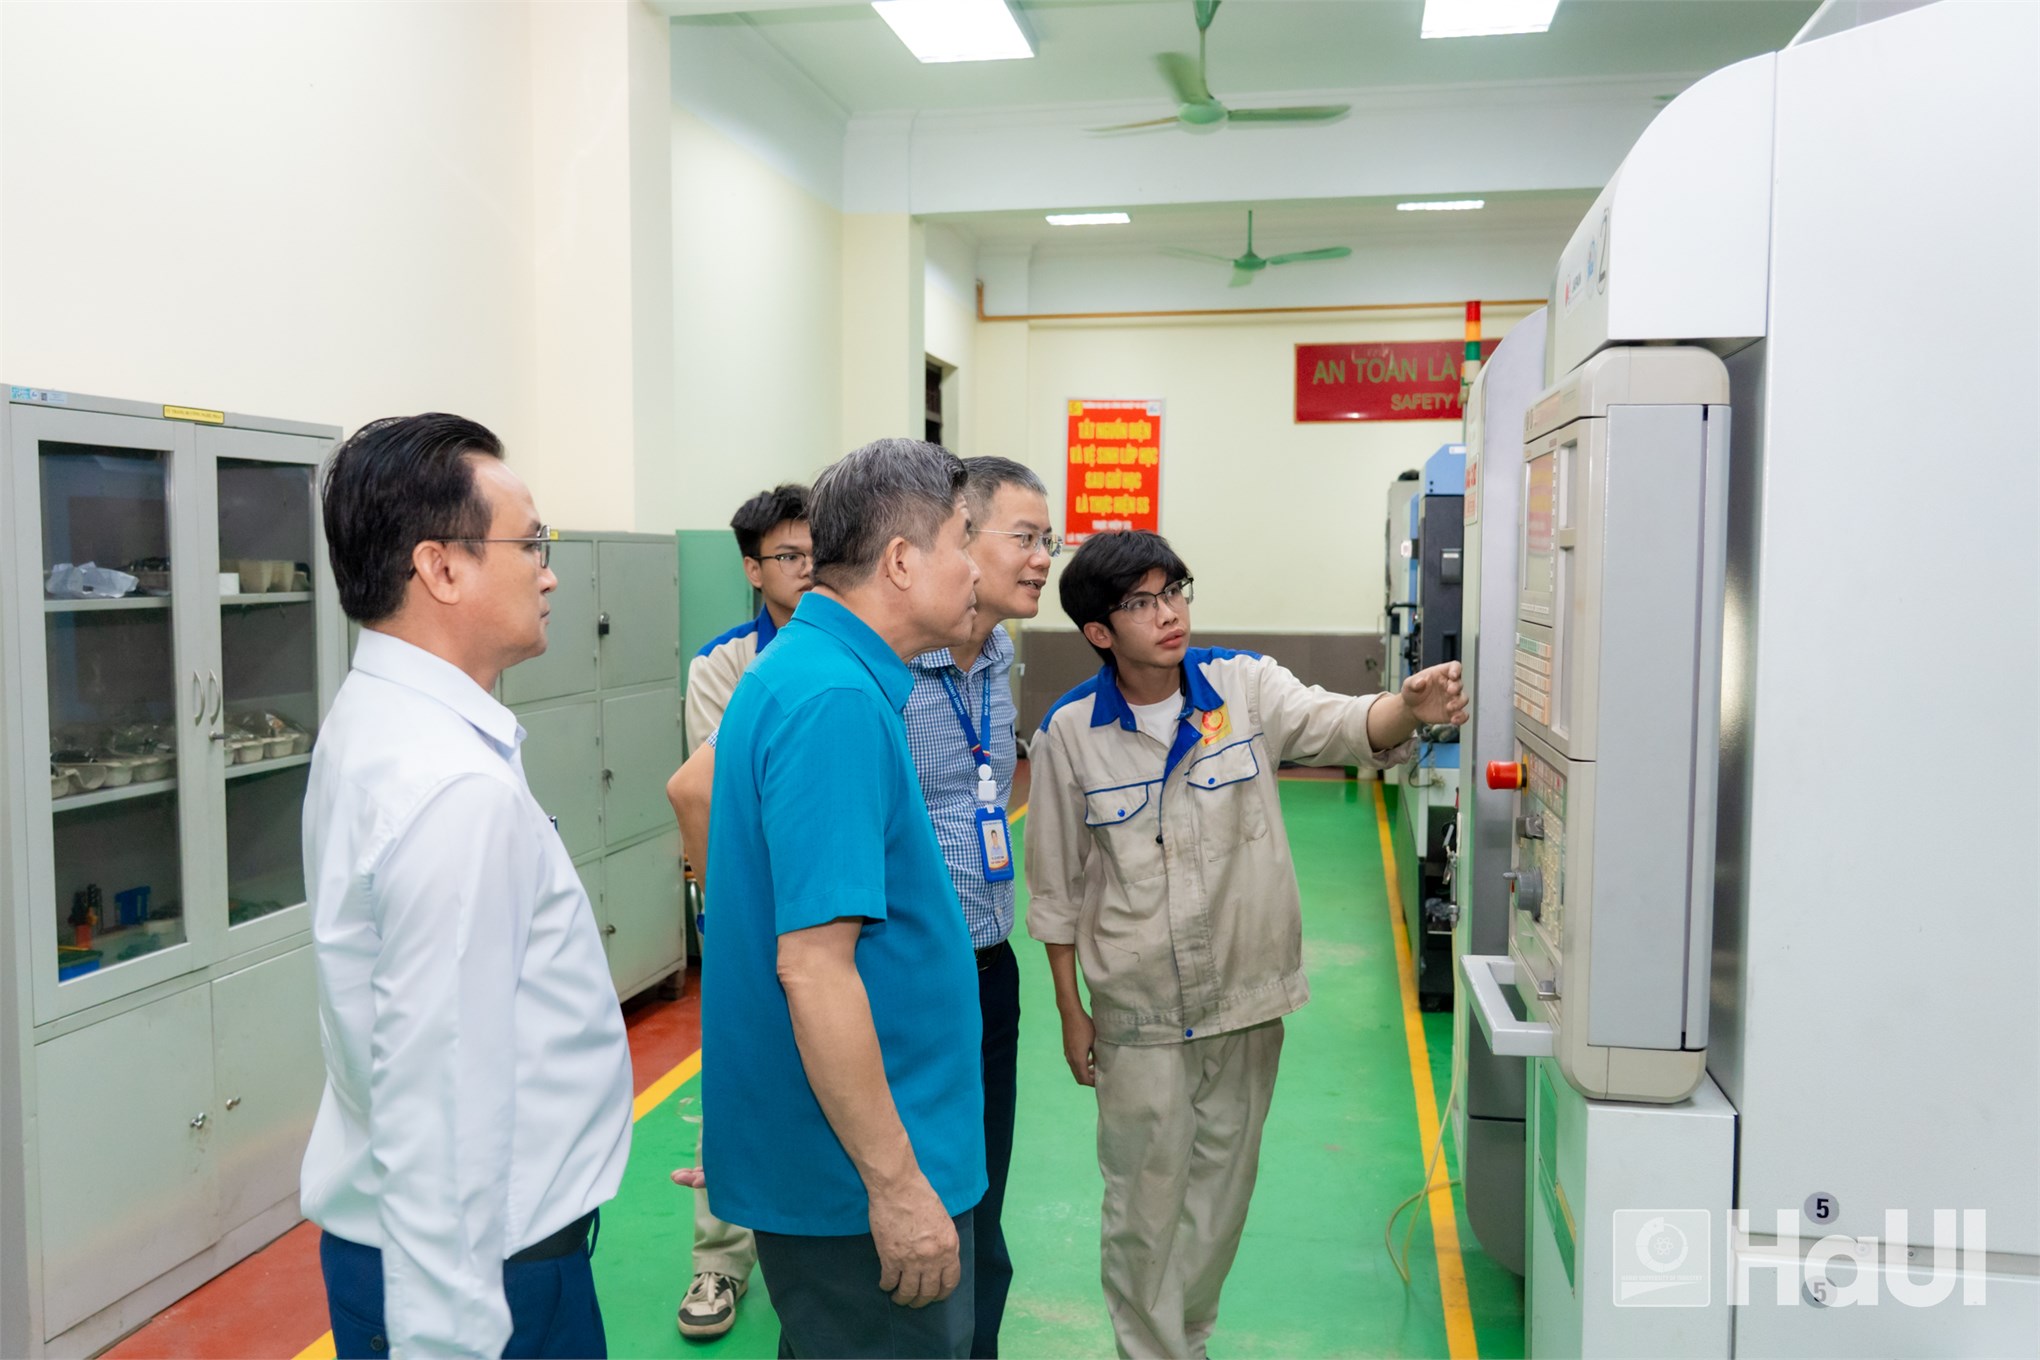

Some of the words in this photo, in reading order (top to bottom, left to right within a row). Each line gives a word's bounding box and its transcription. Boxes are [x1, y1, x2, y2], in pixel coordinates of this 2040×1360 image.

[1312, 358, 1346, 385] AN
[1391, 393, 1454, 411] SAFETY
[1816, 1198, 1829, 1219] 5
